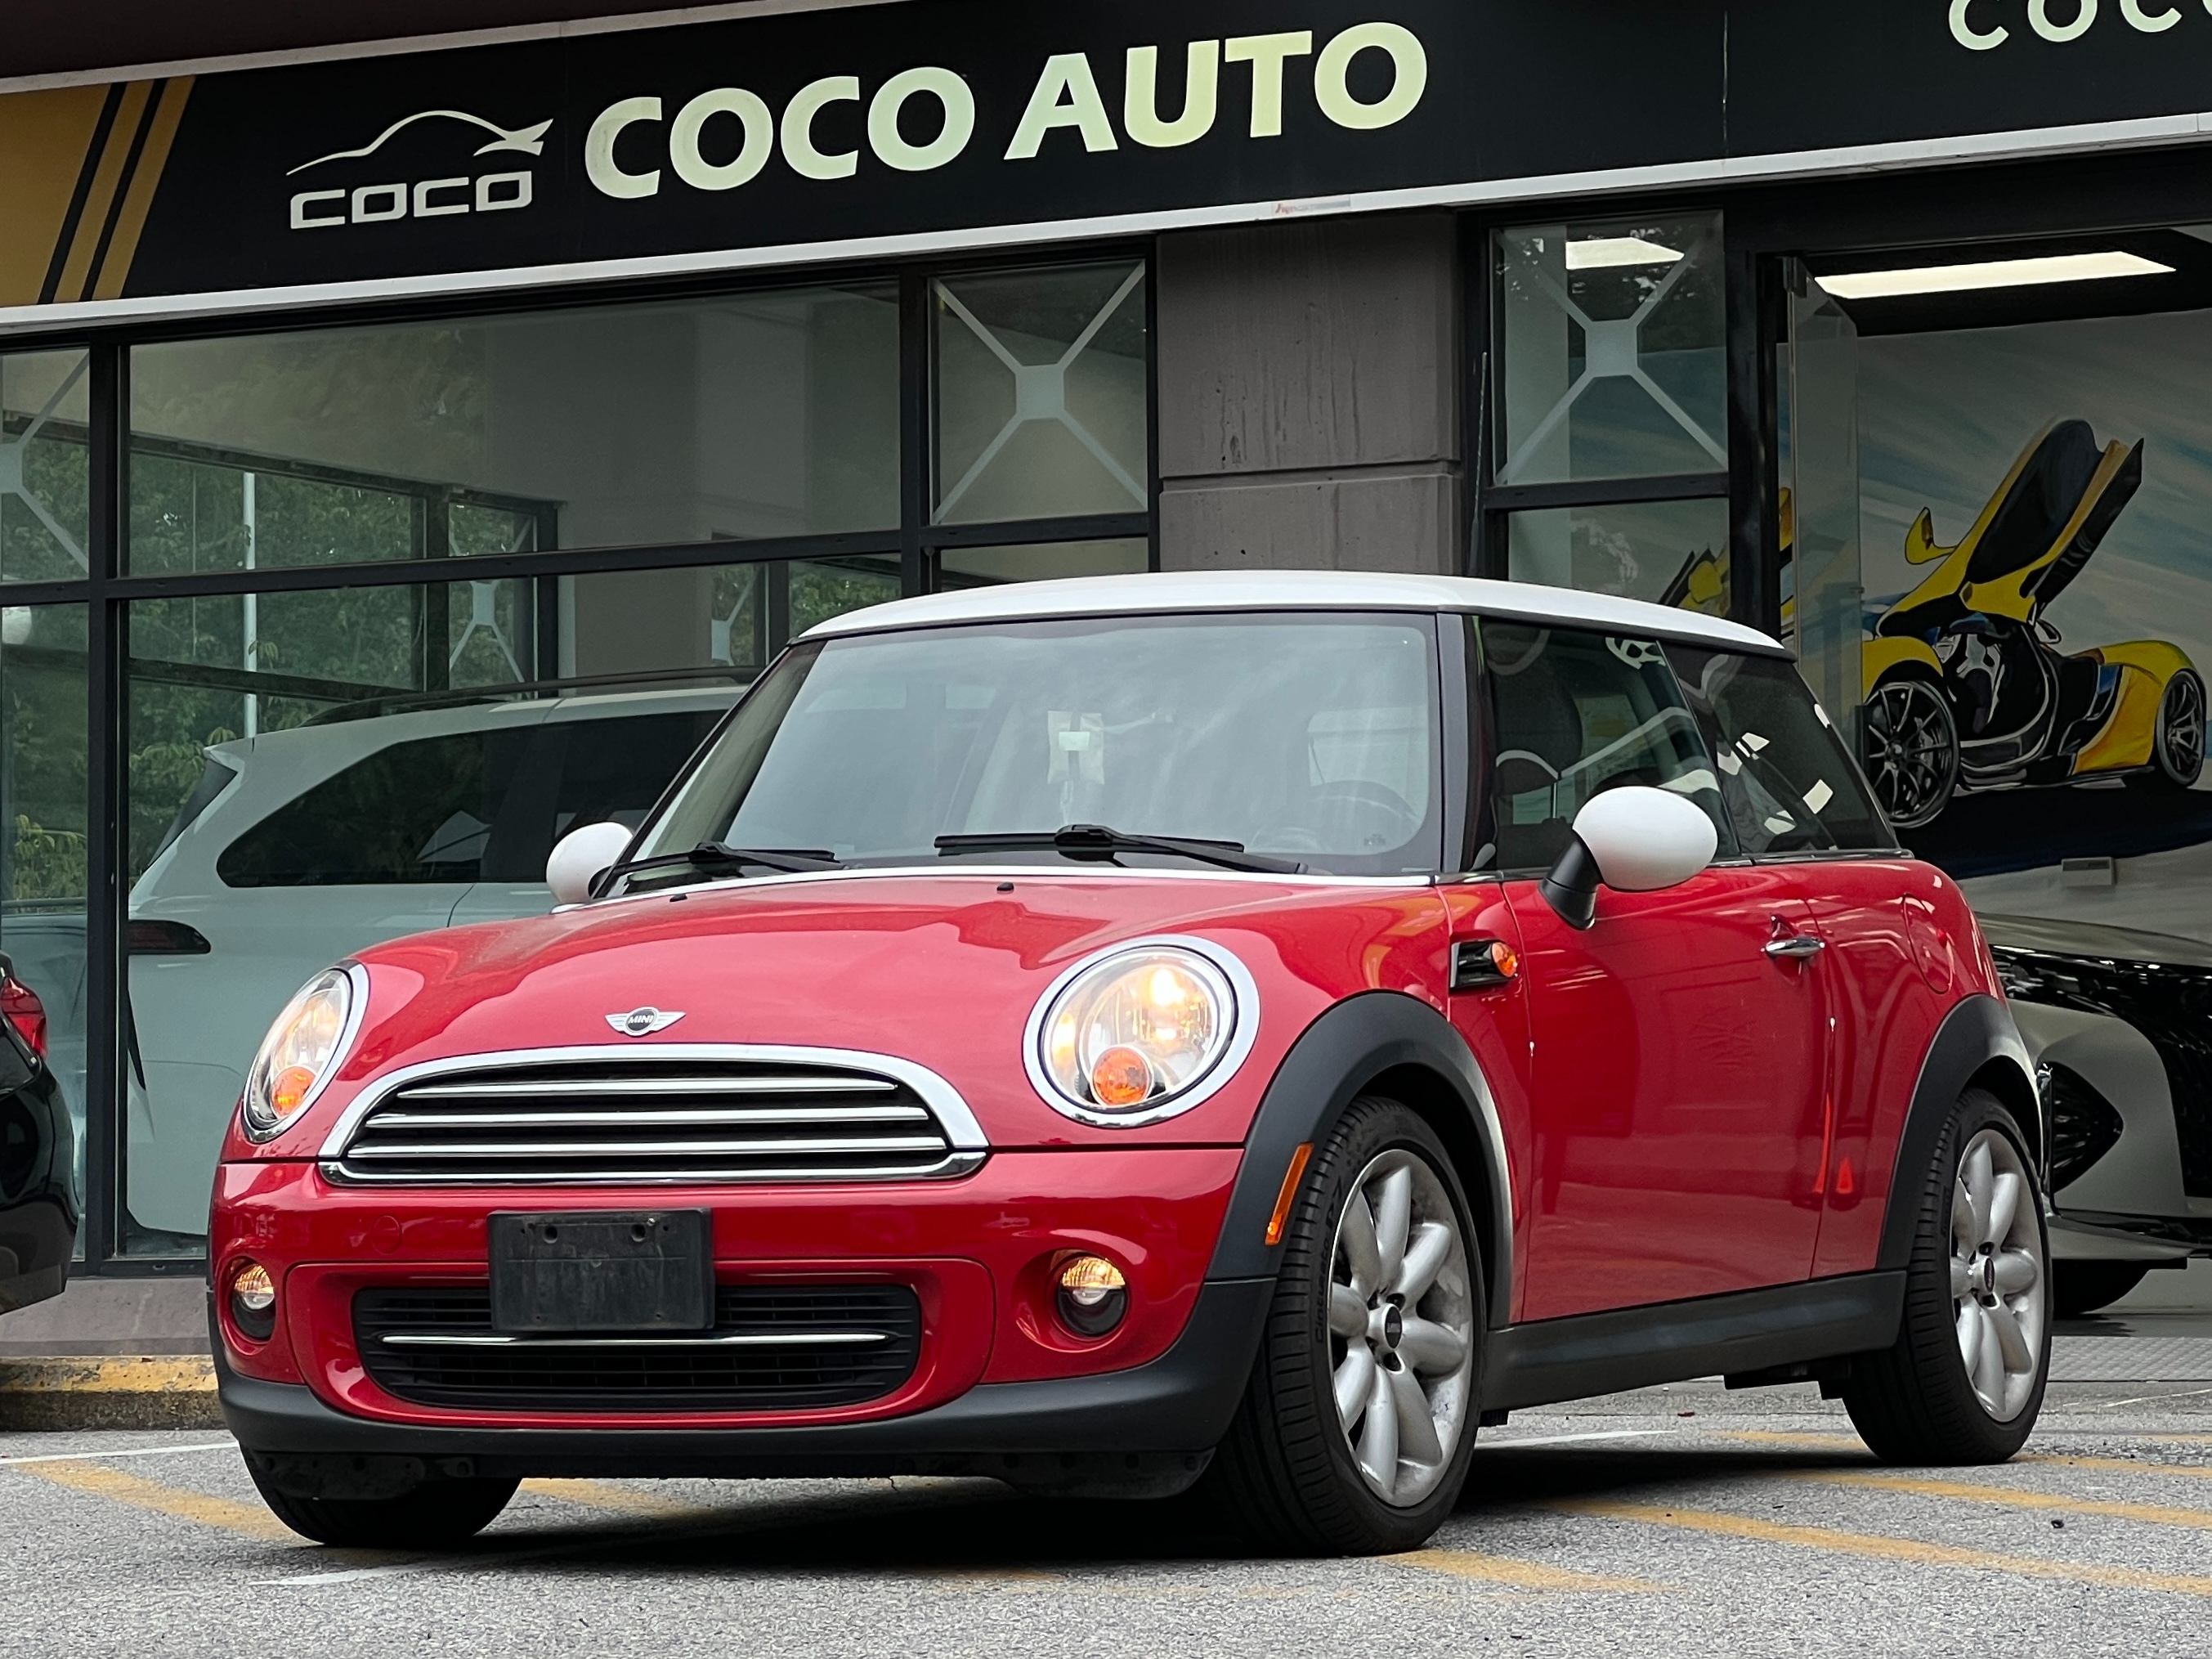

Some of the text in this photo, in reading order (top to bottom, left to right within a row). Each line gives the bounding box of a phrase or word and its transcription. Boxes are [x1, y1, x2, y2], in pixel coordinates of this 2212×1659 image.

[584, 21, 1427, 200] COCO AUTO
[291, 170, 532, 230] COCO
[628, 1015, 654, 1024] MINI
